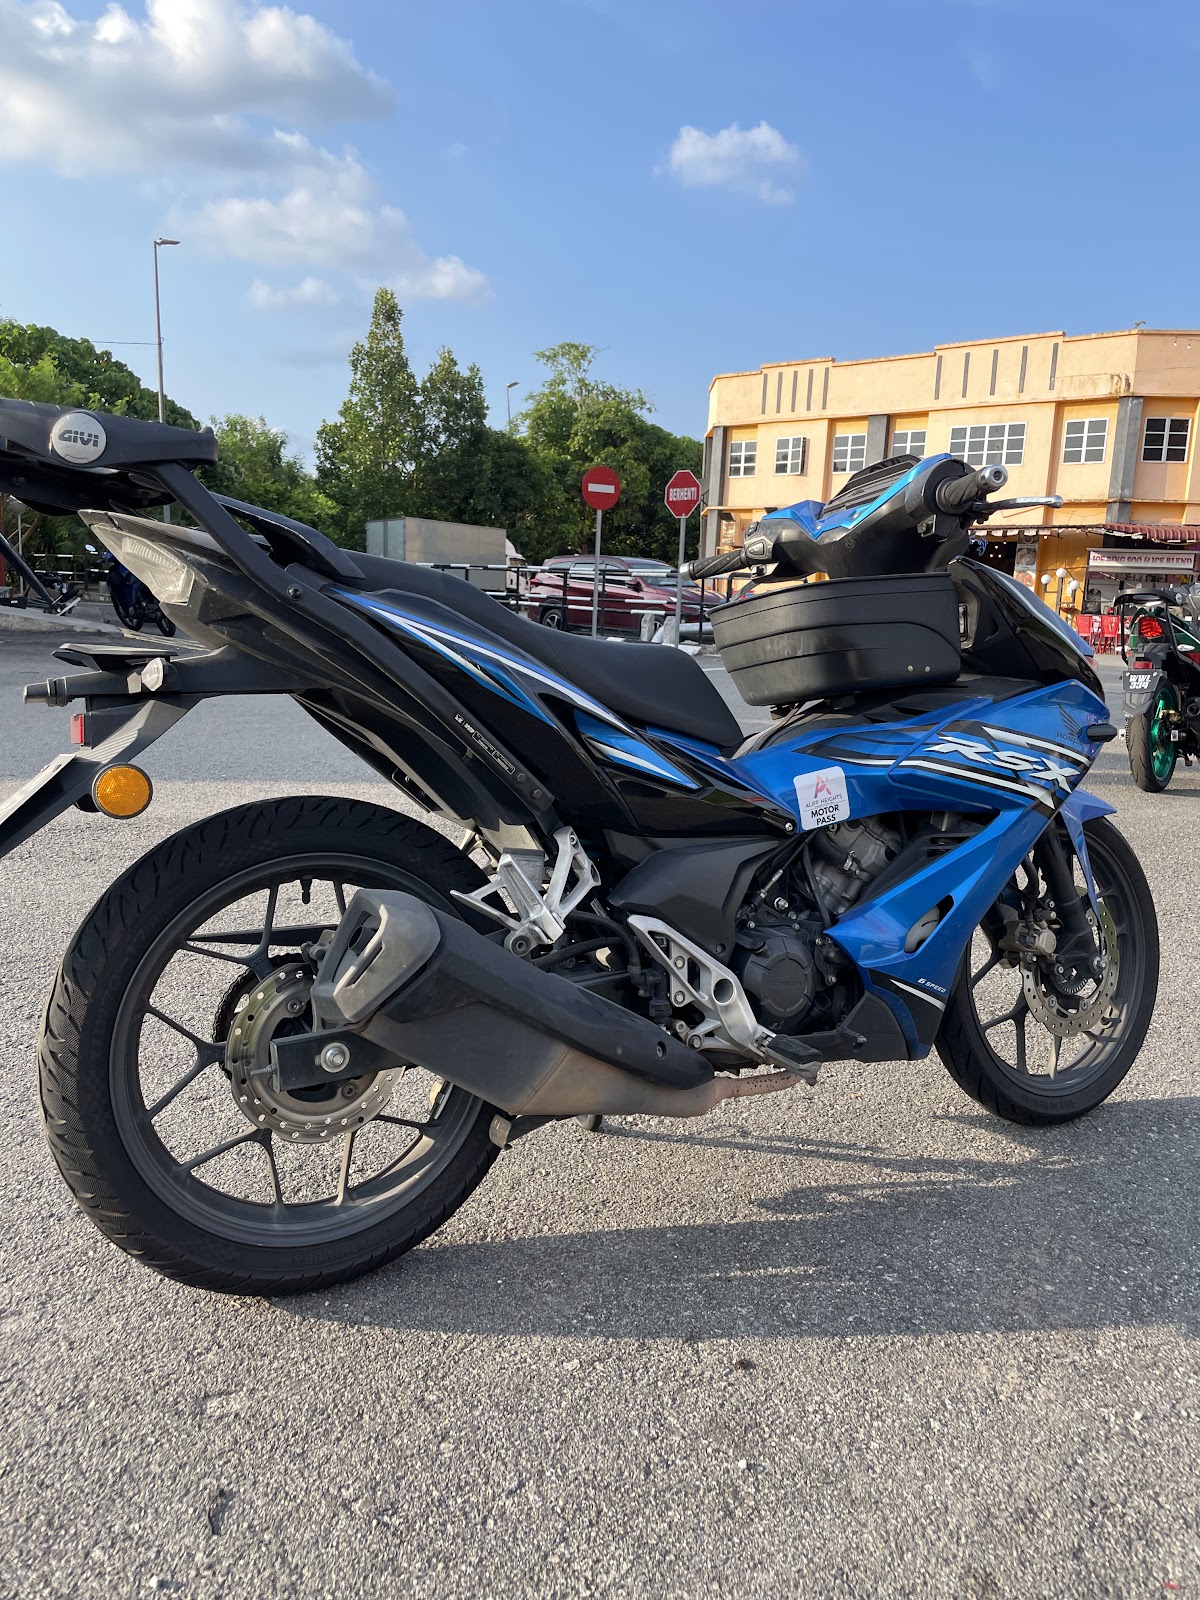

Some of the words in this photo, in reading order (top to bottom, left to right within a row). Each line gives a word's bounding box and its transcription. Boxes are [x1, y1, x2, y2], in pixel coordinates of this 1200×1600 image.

[58, 429, 99, 447] GIVI
[669, 487, 697, 501] BERHENTI
[1152, 556, 1165, 564] ICE
[1166, 557, 1193, 565] BLEND
[1129, 674, 1151, 682] WWL
[820, 793, 843, 804] HEIGHTS
[811, 804, 840, 818] MOTOR
[816, 814, 836, 826] PASS
[925, 981, 947, 993] SPEED
